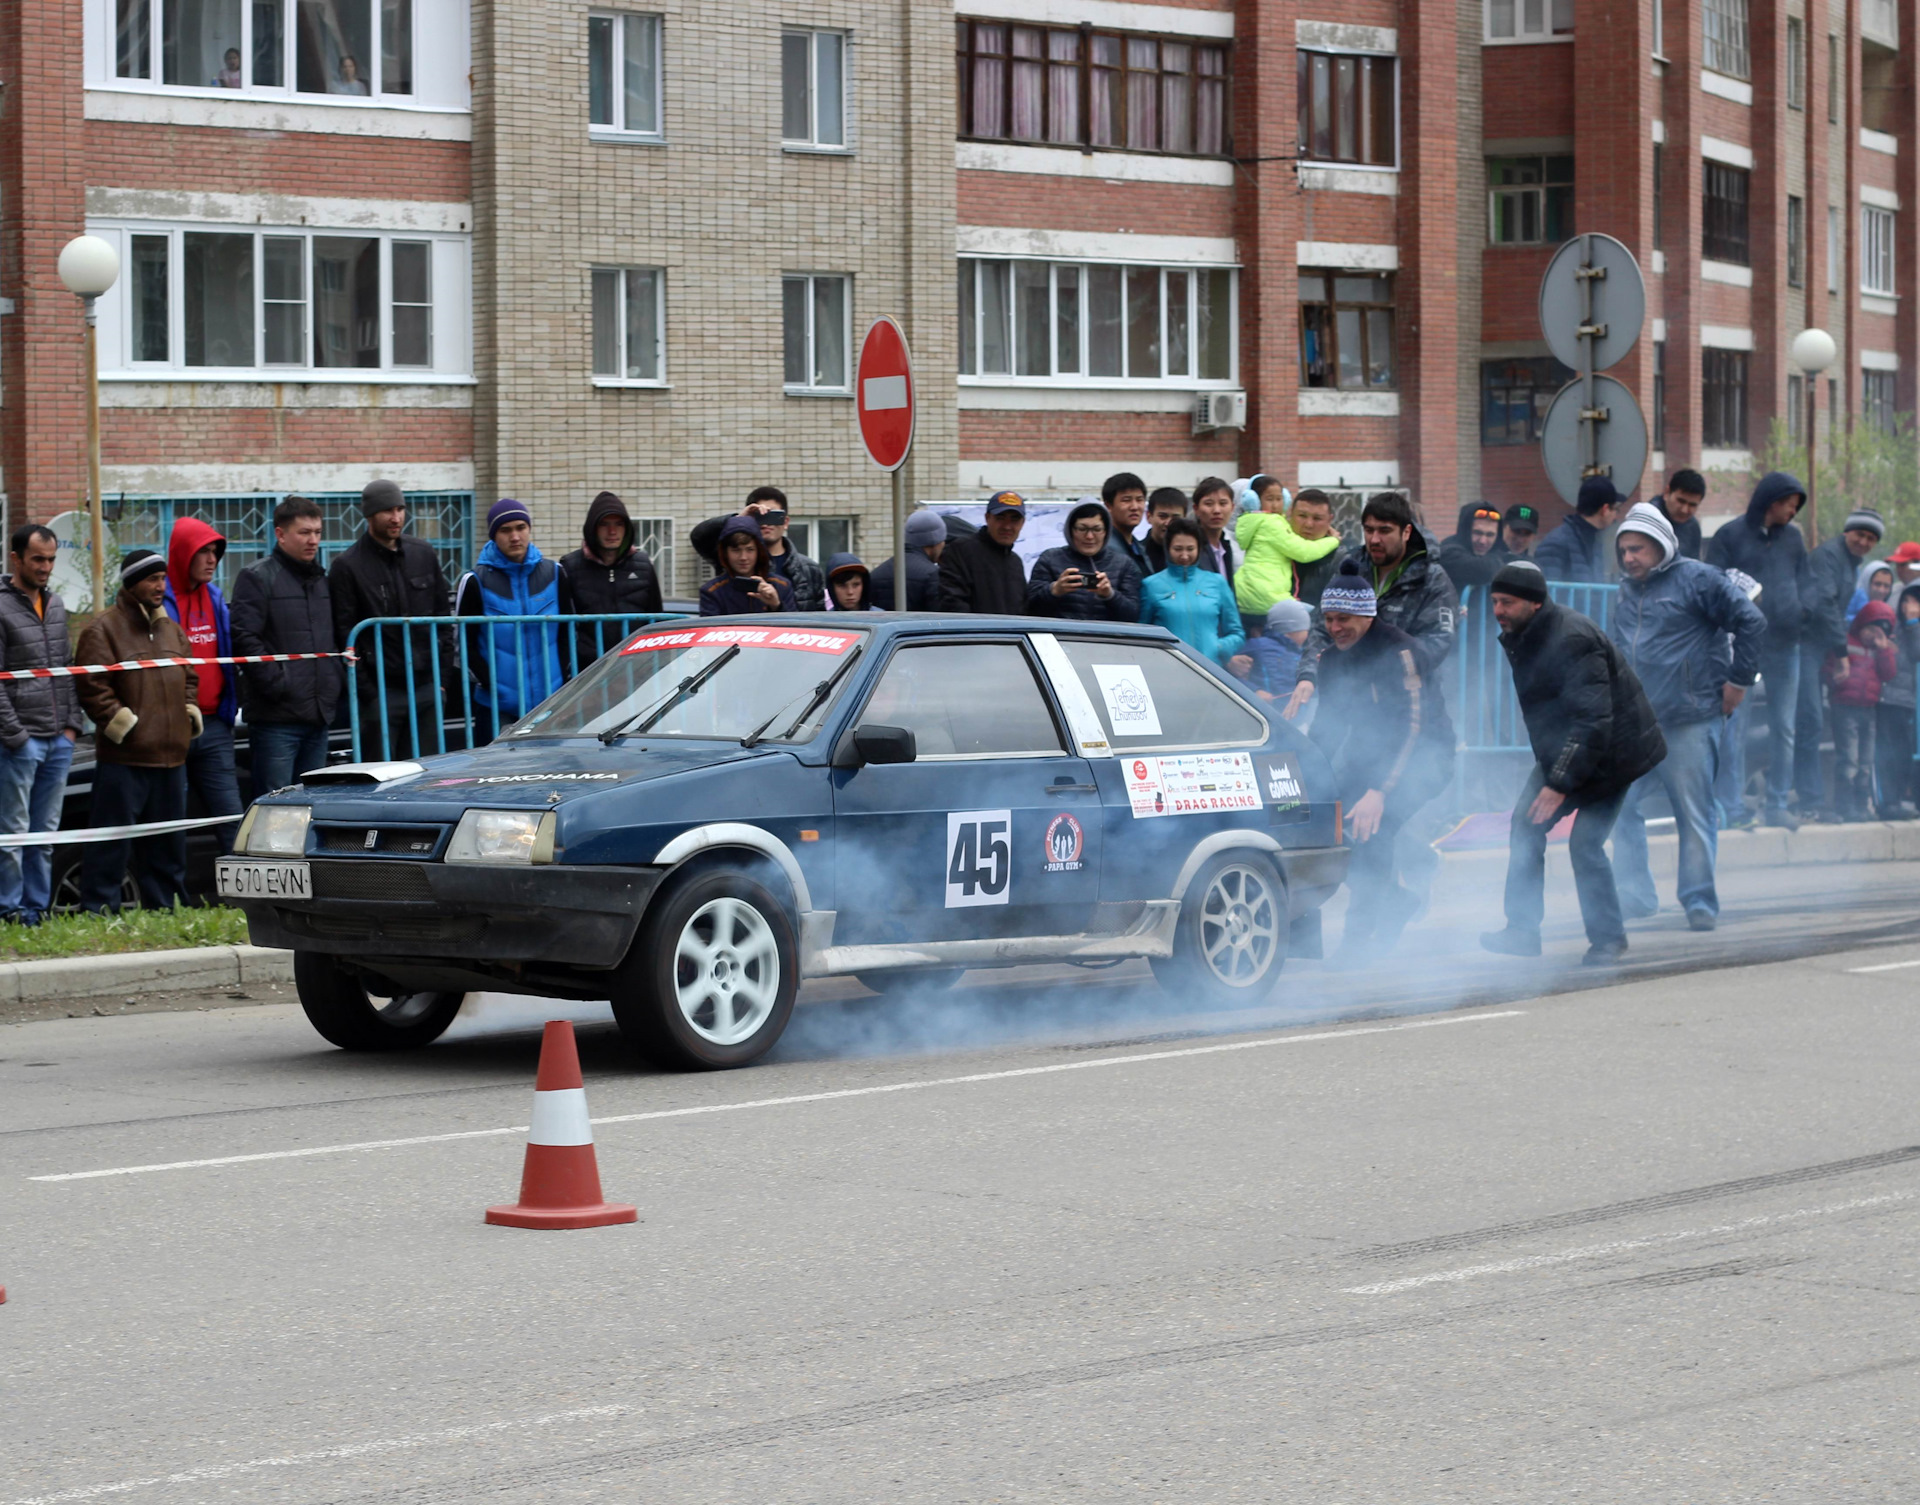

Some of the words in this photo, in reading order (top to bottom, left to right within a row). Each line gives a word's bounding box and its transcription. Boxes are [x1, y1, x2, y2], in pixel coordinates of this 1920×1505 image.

[628, 632, 697, 650] MOTUL
[697, 630, 770, 643] MOTUL
[770, 632, 848, 650] MOTUL
[477, 773, 618, 784] YOKOHAMA
[1269, 779, 1301, 798] GORILLA
[1175, 798, 1207, 811] DRAG
[1210, 795, 1255, 808] RACING
[949, 821, 1009, 896] 45
[1048, 862, 1064, 871] PAPA
[1065, 861, 1079, 870] GYM
[220, 867, 229, 893] F
[235, 867, 262, 893] 670
[267, 867, 305, 894] EVN
